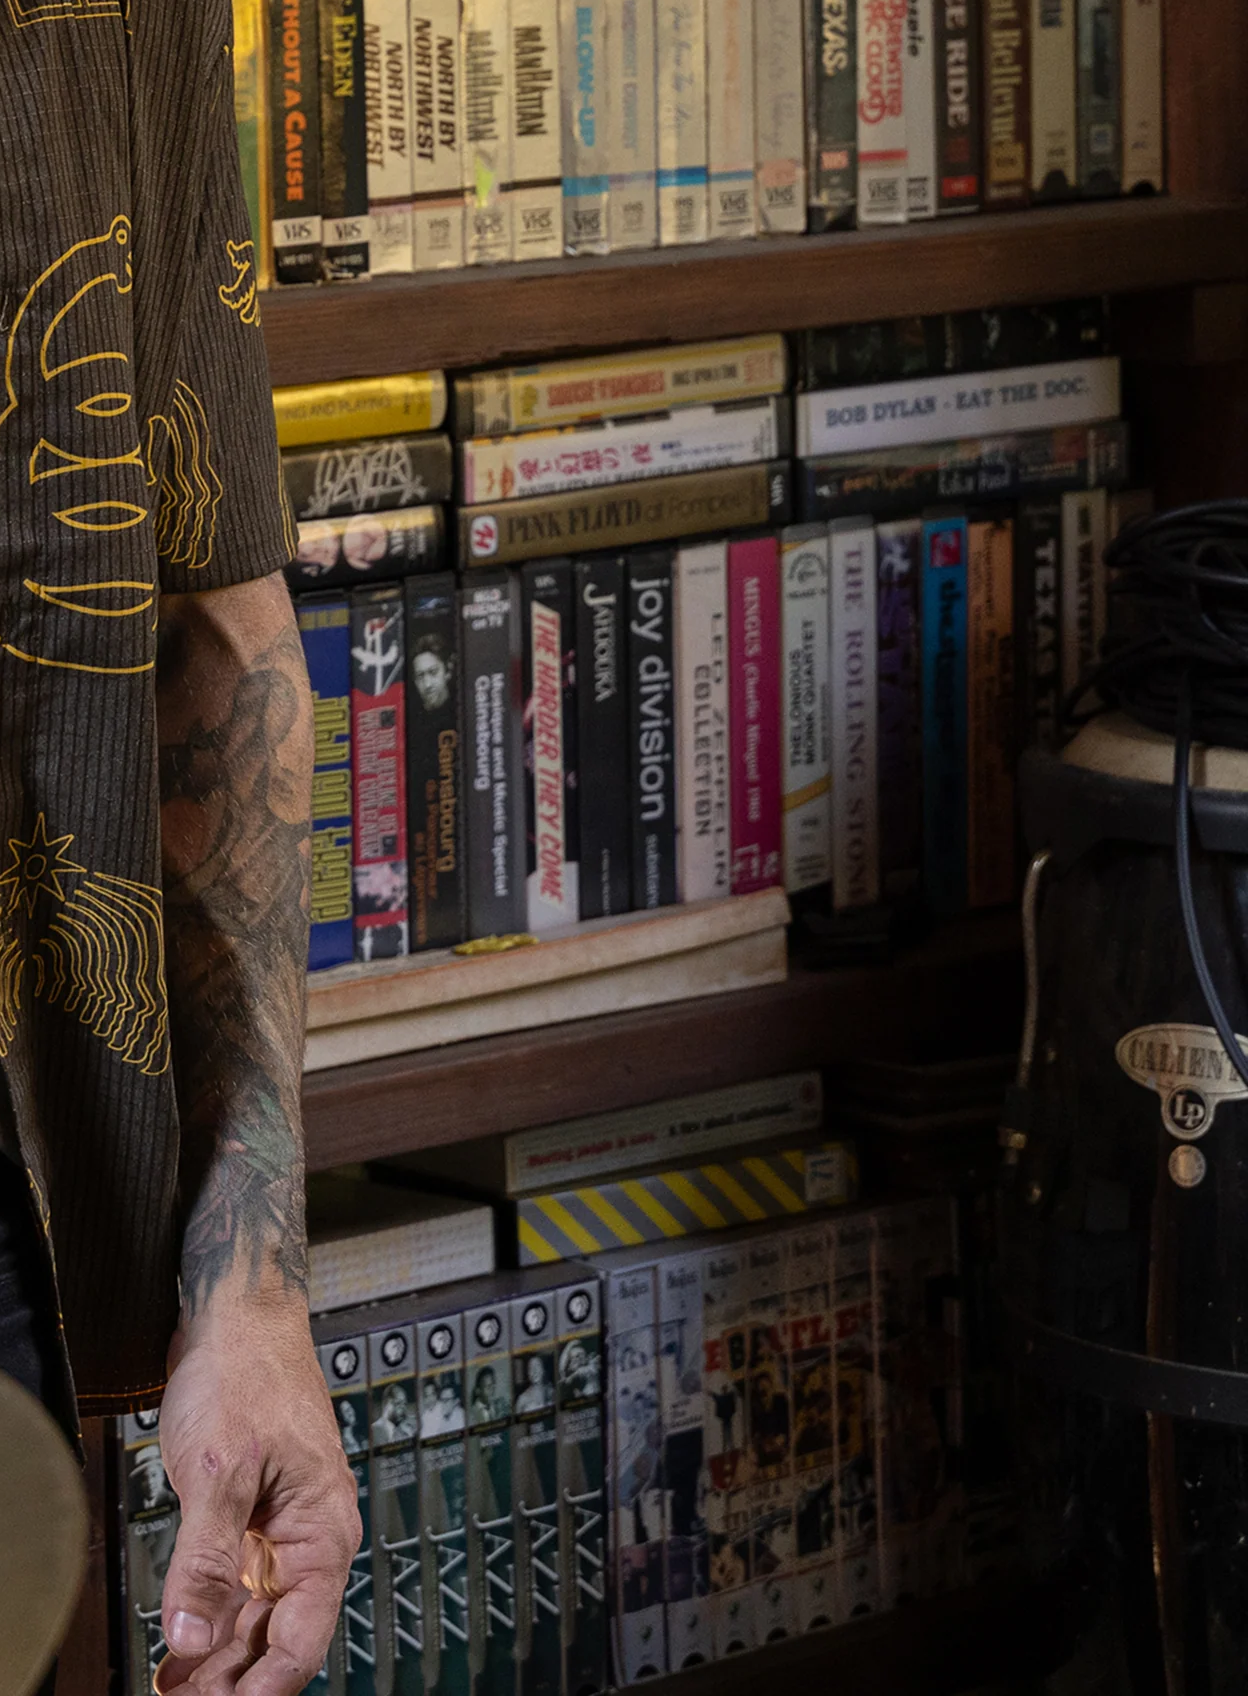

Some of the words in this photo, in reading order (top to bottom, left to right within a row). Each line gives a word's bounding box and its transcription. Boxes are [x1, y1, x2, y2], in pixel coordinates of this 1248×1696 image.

[330, 11, 360, 99] EDEN
[364, 21, 386, 169] NORTHWEST
[385, 40, 406, 122] NORTH
[413, 16, 436, 164] NORTHWEST
[435, 35, 456, 116] NORTH
[574, 6, 597, 148] BLOW-UP
[944, 37, 971, 130] RIDE
[282, 87, 303, 108] A
[438, 120, 458, 153] BY
[283, 113, 308, 202] CAUSE
[387, 126, 408, 158] BY
[825, 405, 869, 429] BOB
[872, 395, 938, 422] DYLAN
[955, 388, 995, 412] EAT
[998, 381, 1038, 404] THE
[506, 509, 561, 546] PINK
[567, 497, 642, 536] FLOYD
[630, 576, 670, 642] joy
[743, 576, 762, 658] MINGUS
[844, 545, 865, 610] THE
[1034, 538, 1058, 677] TEXAS
[534, 612, 560, 660] THE
[801, 619, 817, 706] QUARTET
[472, 674, 492, 792] Gainsbourg
[489, 671, 507, 744] Musique
[534, 664, 561, 764] HARDER
[639, 654, 671, 822] division
[788, 648, 803, 768] THELONIOUS
[803, 712, 817, 767] MONK
[844, 629, 867, 782] ROLLING
[491, 746, 507, 780] and
[693, 664, 713, 838] COLLECTION
[435, 728, 459, 873] Gainsbourg
[492, 781, 509, 833] Music
[535, 768, 563, 836] THEY
[711, 707, 728, 888] ZEPPELIN
[491, 834, 510, 897] Special
[538, 838, 564, 904] COME
[1173, 1092, 1205, 1128] LP
